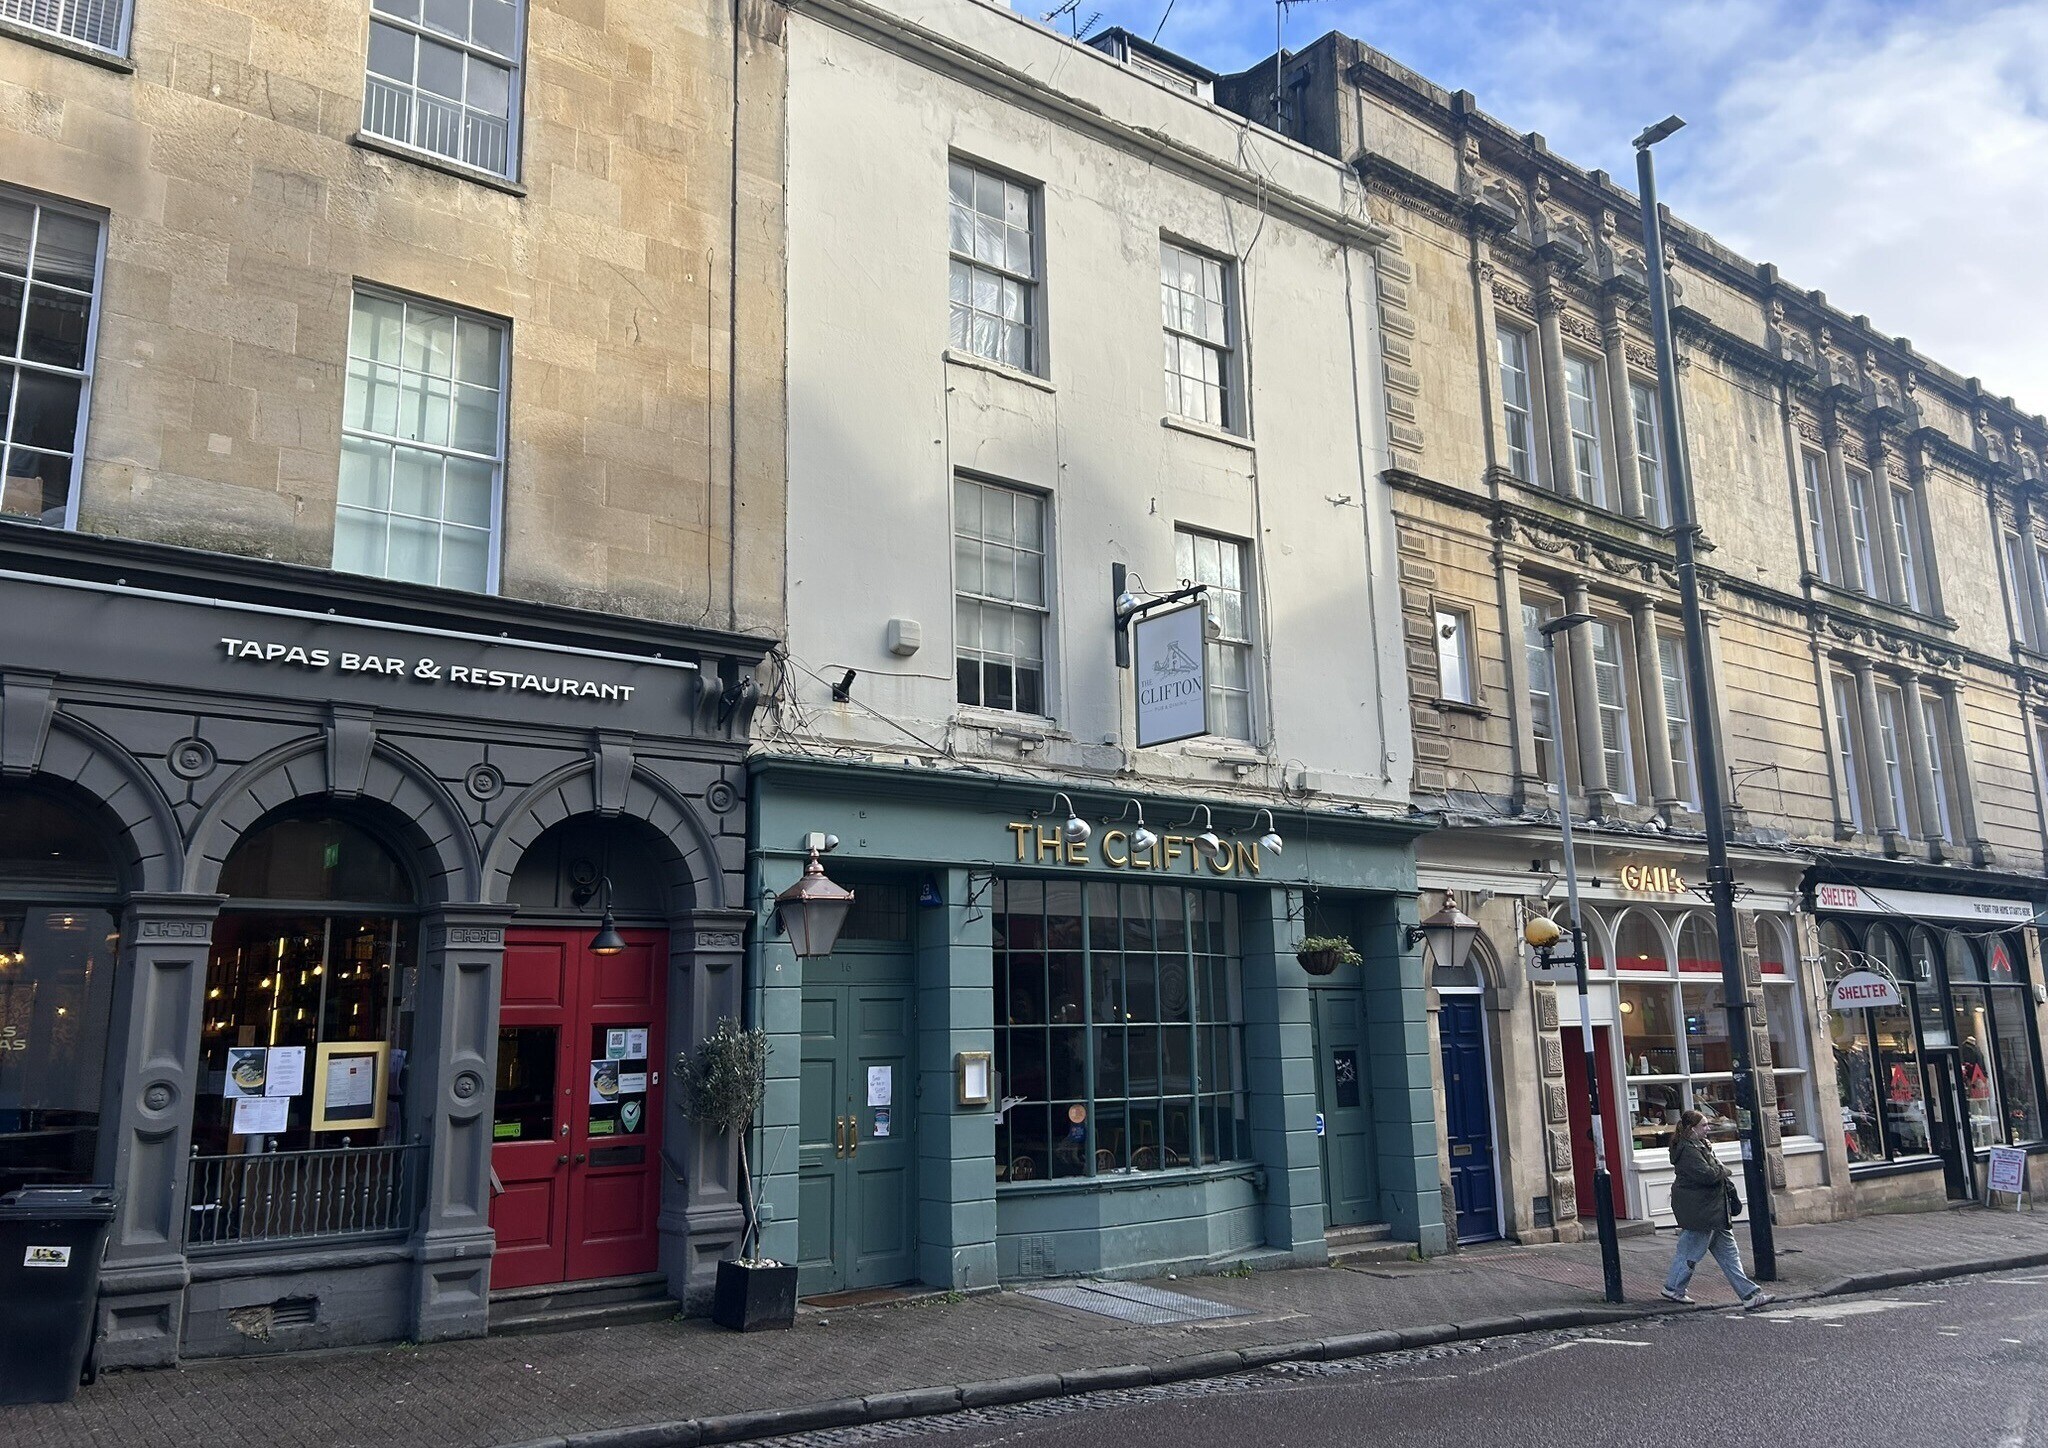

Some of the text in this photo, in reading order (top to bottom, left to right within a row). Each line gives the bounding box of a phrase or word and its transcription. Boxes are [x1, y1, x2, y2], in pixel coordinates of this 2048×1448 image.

[221, 637, 635, 701] TAPAS BAR & RESTAURANT
[1140, 676, 1202, 706] CLIFTON
[1141, 678, 1153, 688] THE
[1008, 822, 1261, 875] THE CLIFTON
[1821, 886, 1858, 907] SHELTER
[841, 961, 851, 972] 16
[1918, 959, 1931, 978] 12
[1838, 984, 1888, 1000] SHELTER
